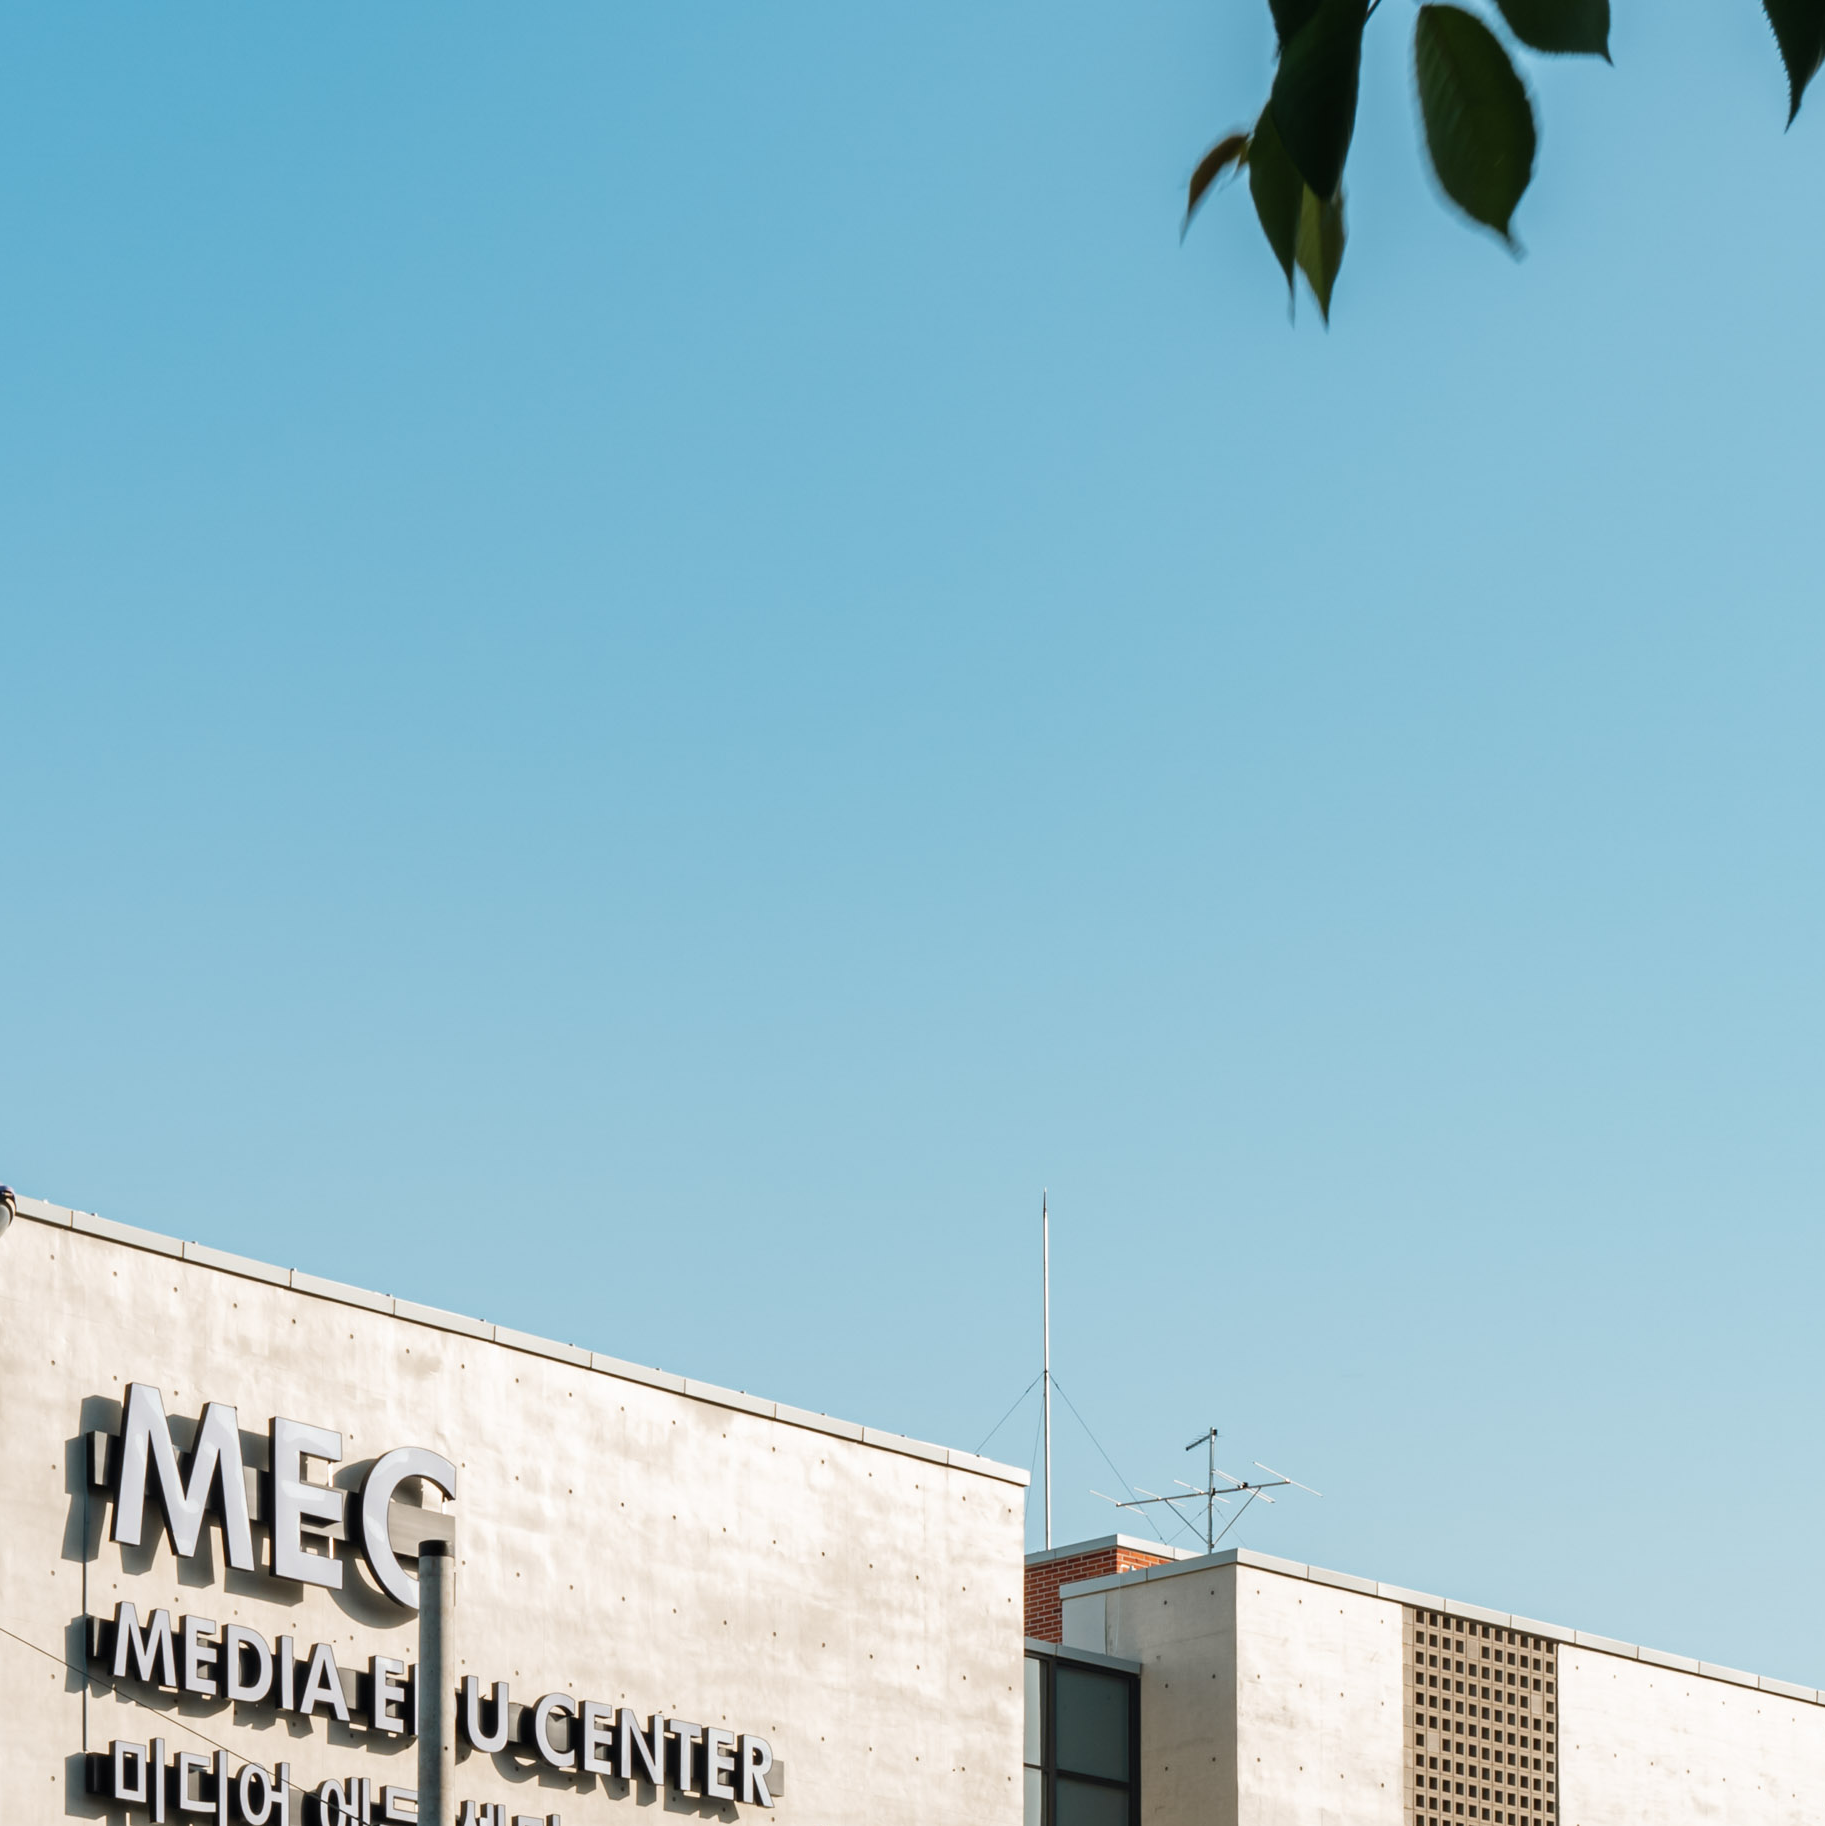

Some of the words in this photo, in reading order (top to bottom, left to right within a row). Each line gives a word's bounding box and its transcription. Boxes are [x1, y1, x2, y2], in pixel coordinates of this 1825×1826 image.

[111, 1381, 457, 1610] MEC
[112, 1601, 352, 1722] MEDIA
[368, 1654, 510, 1753] EU
[533, 1691, 775, 1808] CENTER
